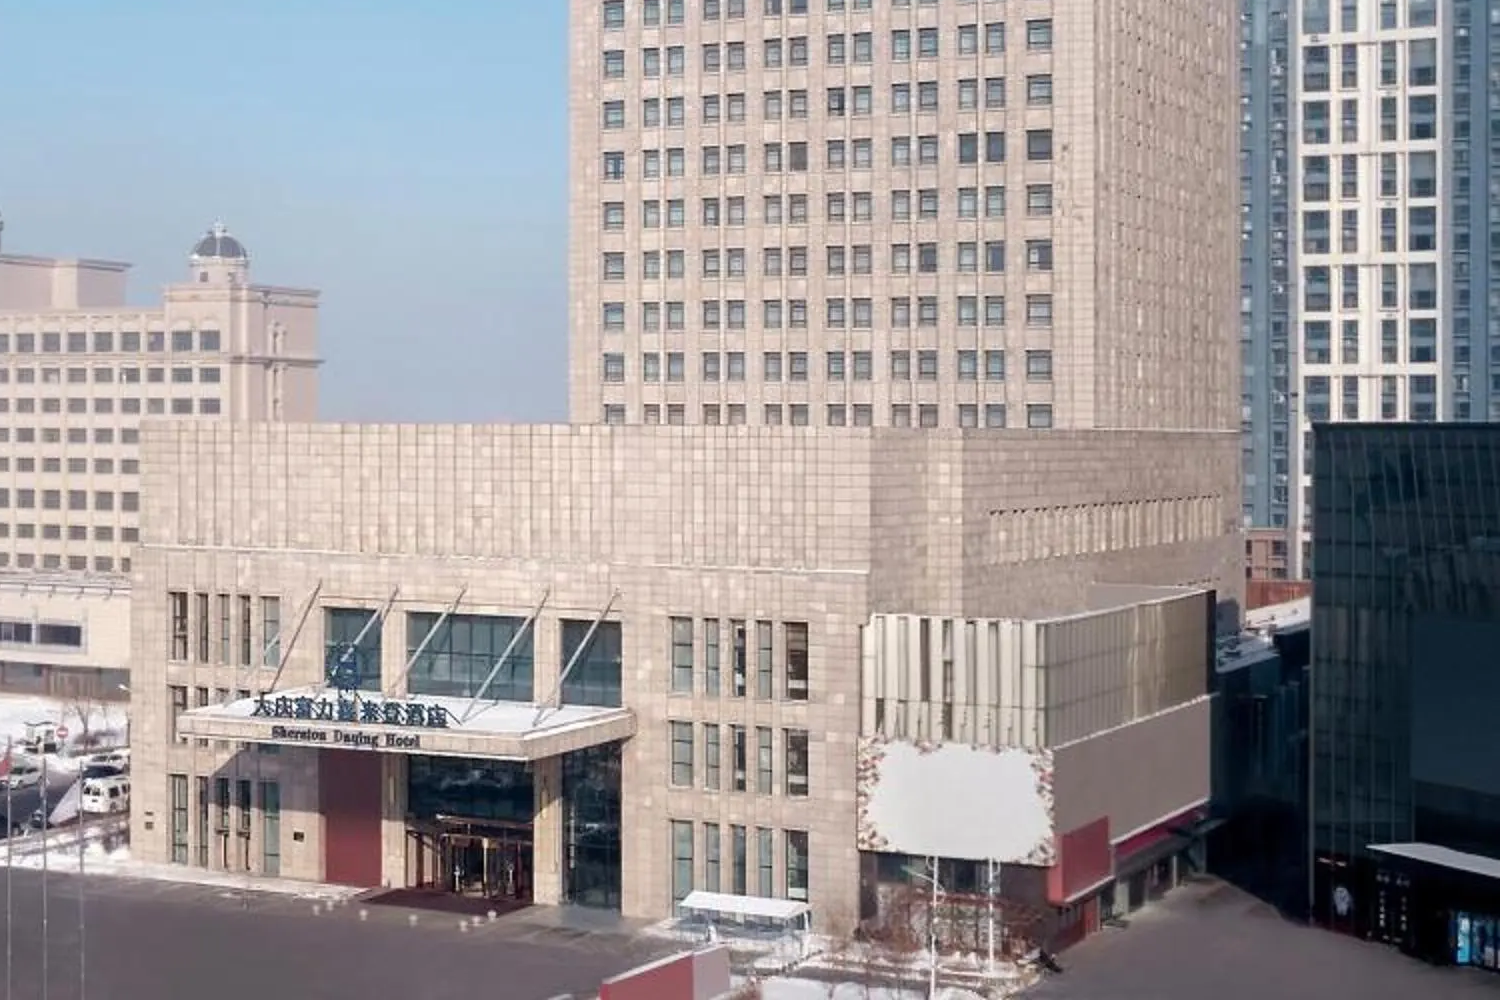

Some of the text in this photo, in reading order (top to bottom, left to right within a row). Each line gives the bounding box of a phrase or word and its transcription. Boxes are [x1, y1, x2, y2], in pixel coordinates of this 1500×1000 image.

[272, 726, 420, 748] Sheraton Daqing Hotel
